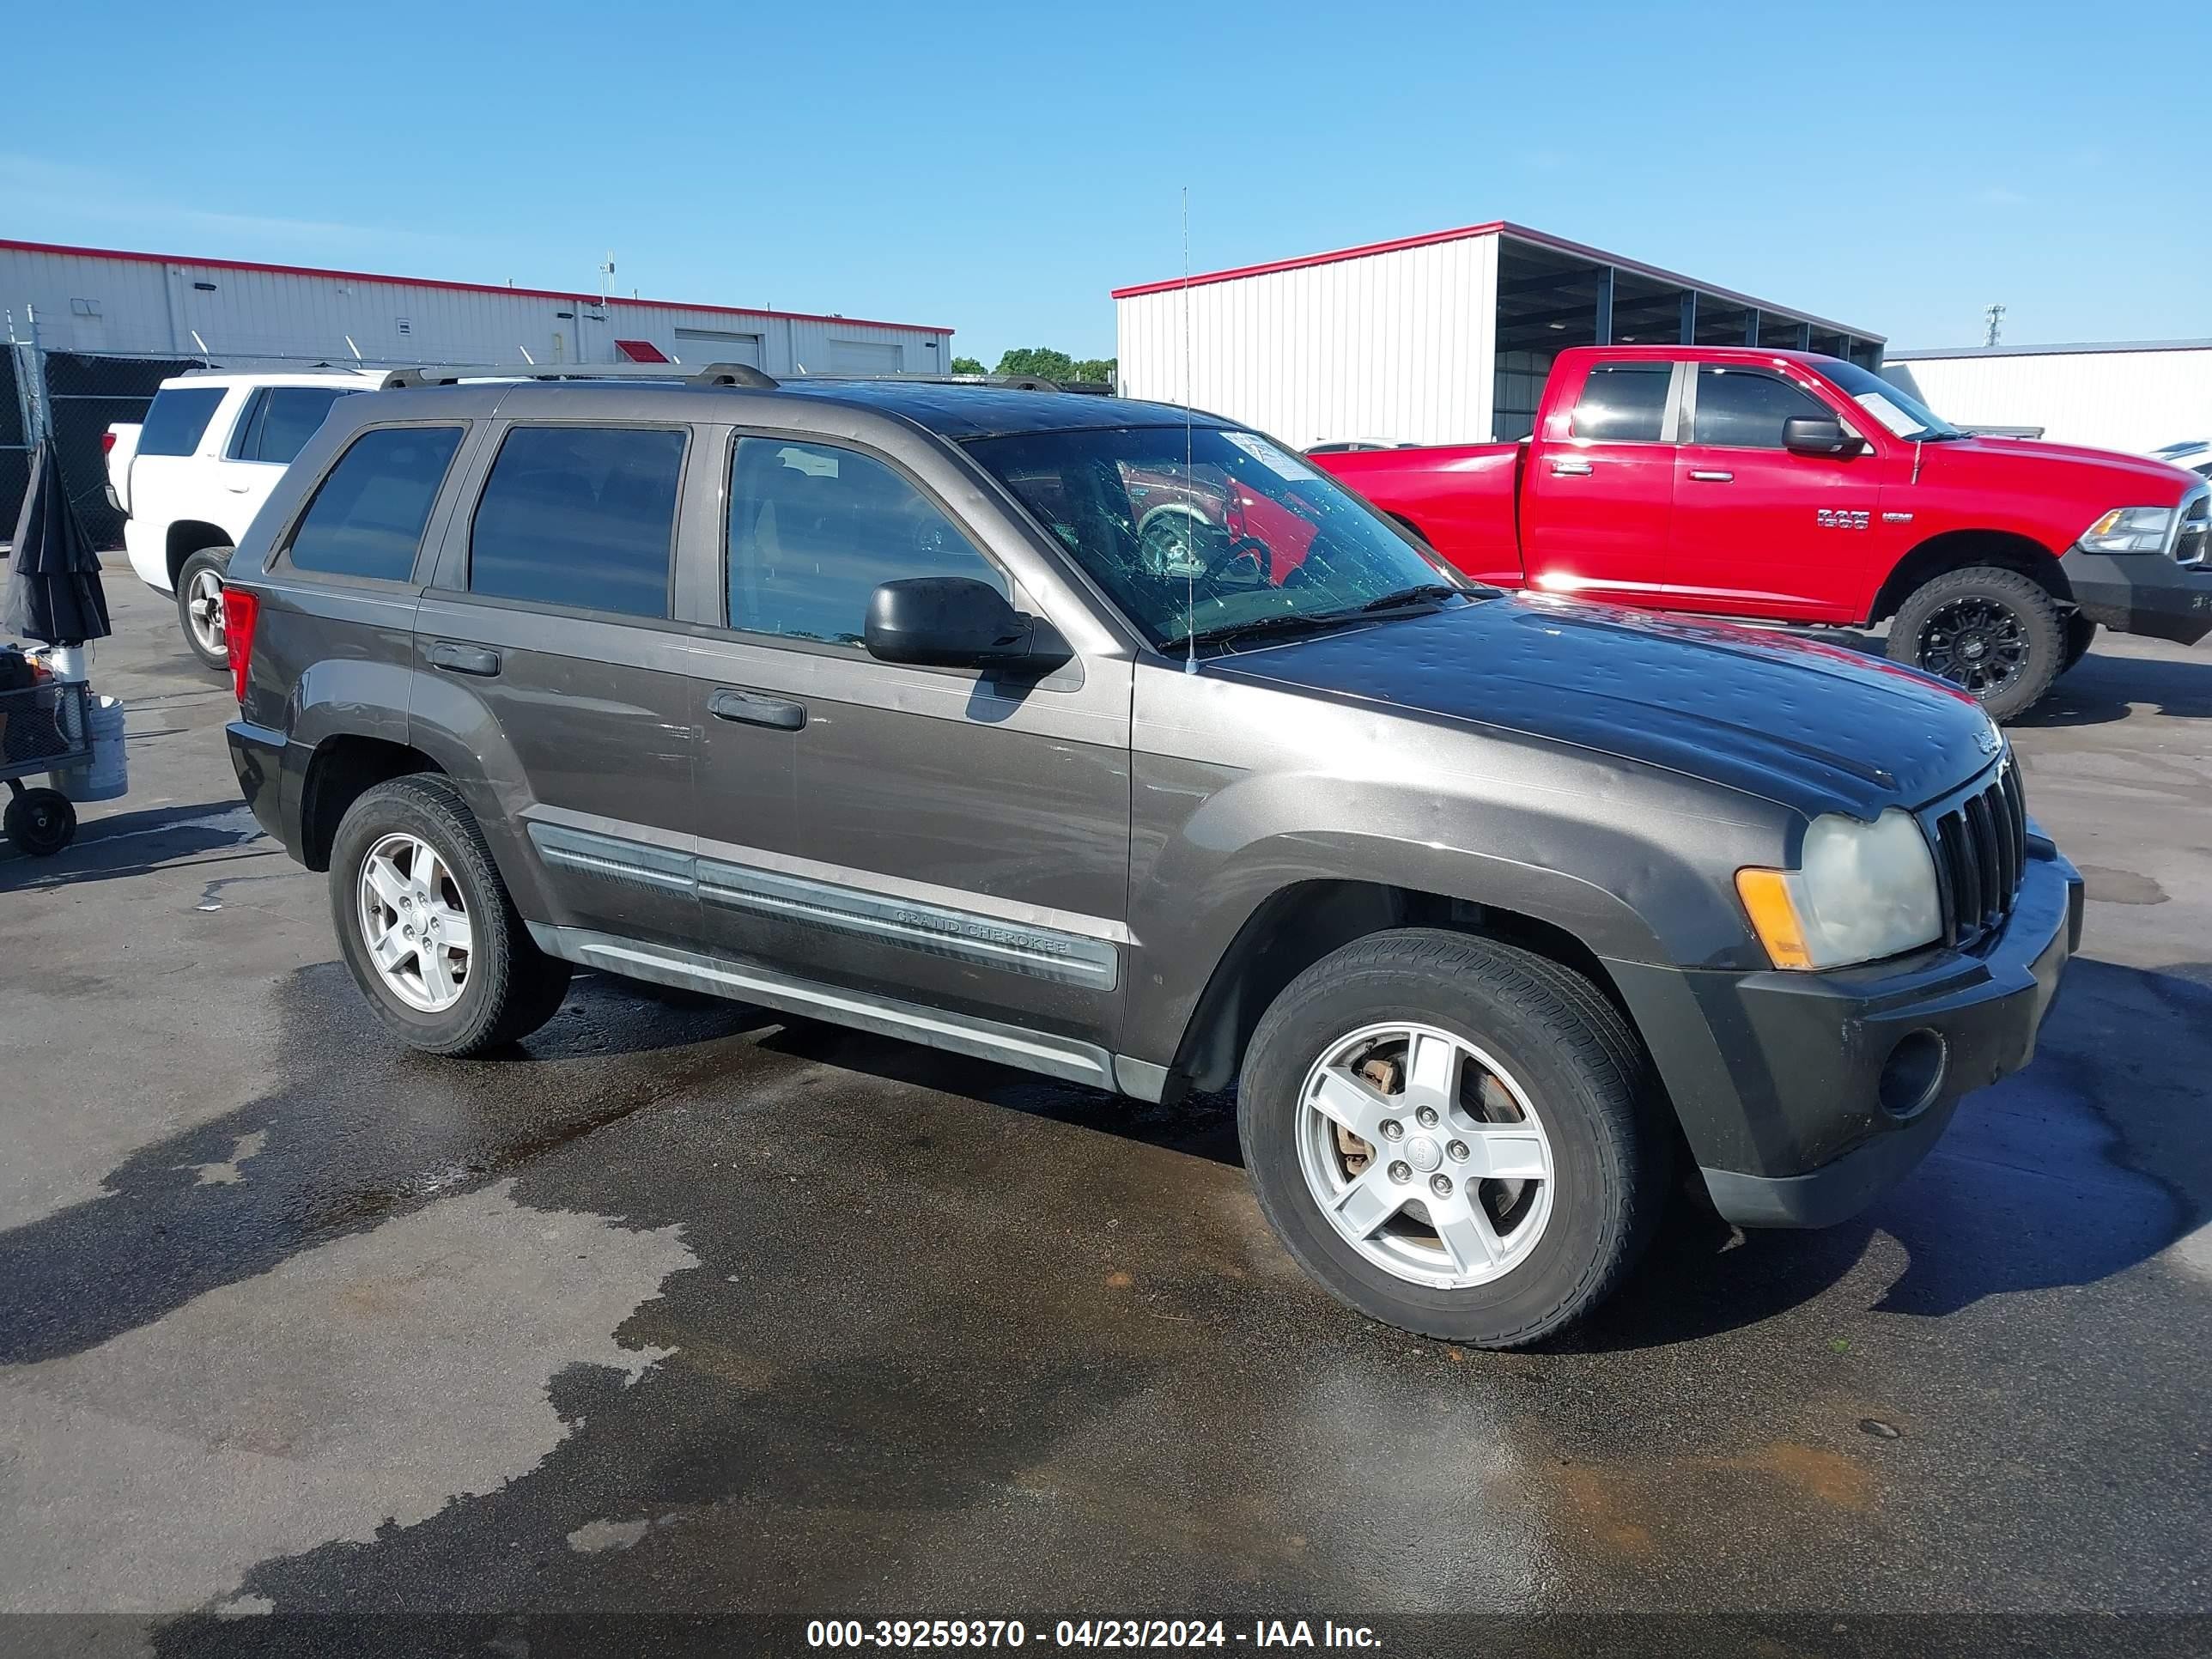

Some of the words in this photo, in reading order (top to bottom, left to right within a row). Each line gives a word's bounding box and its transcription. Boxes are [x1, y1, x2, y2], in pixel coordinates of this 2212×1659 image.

[1817, 518, 1869, 530] 1500
[895, 910, 960, 932] GRAND
[967, 924, 1071, 954] CHEROKEE
